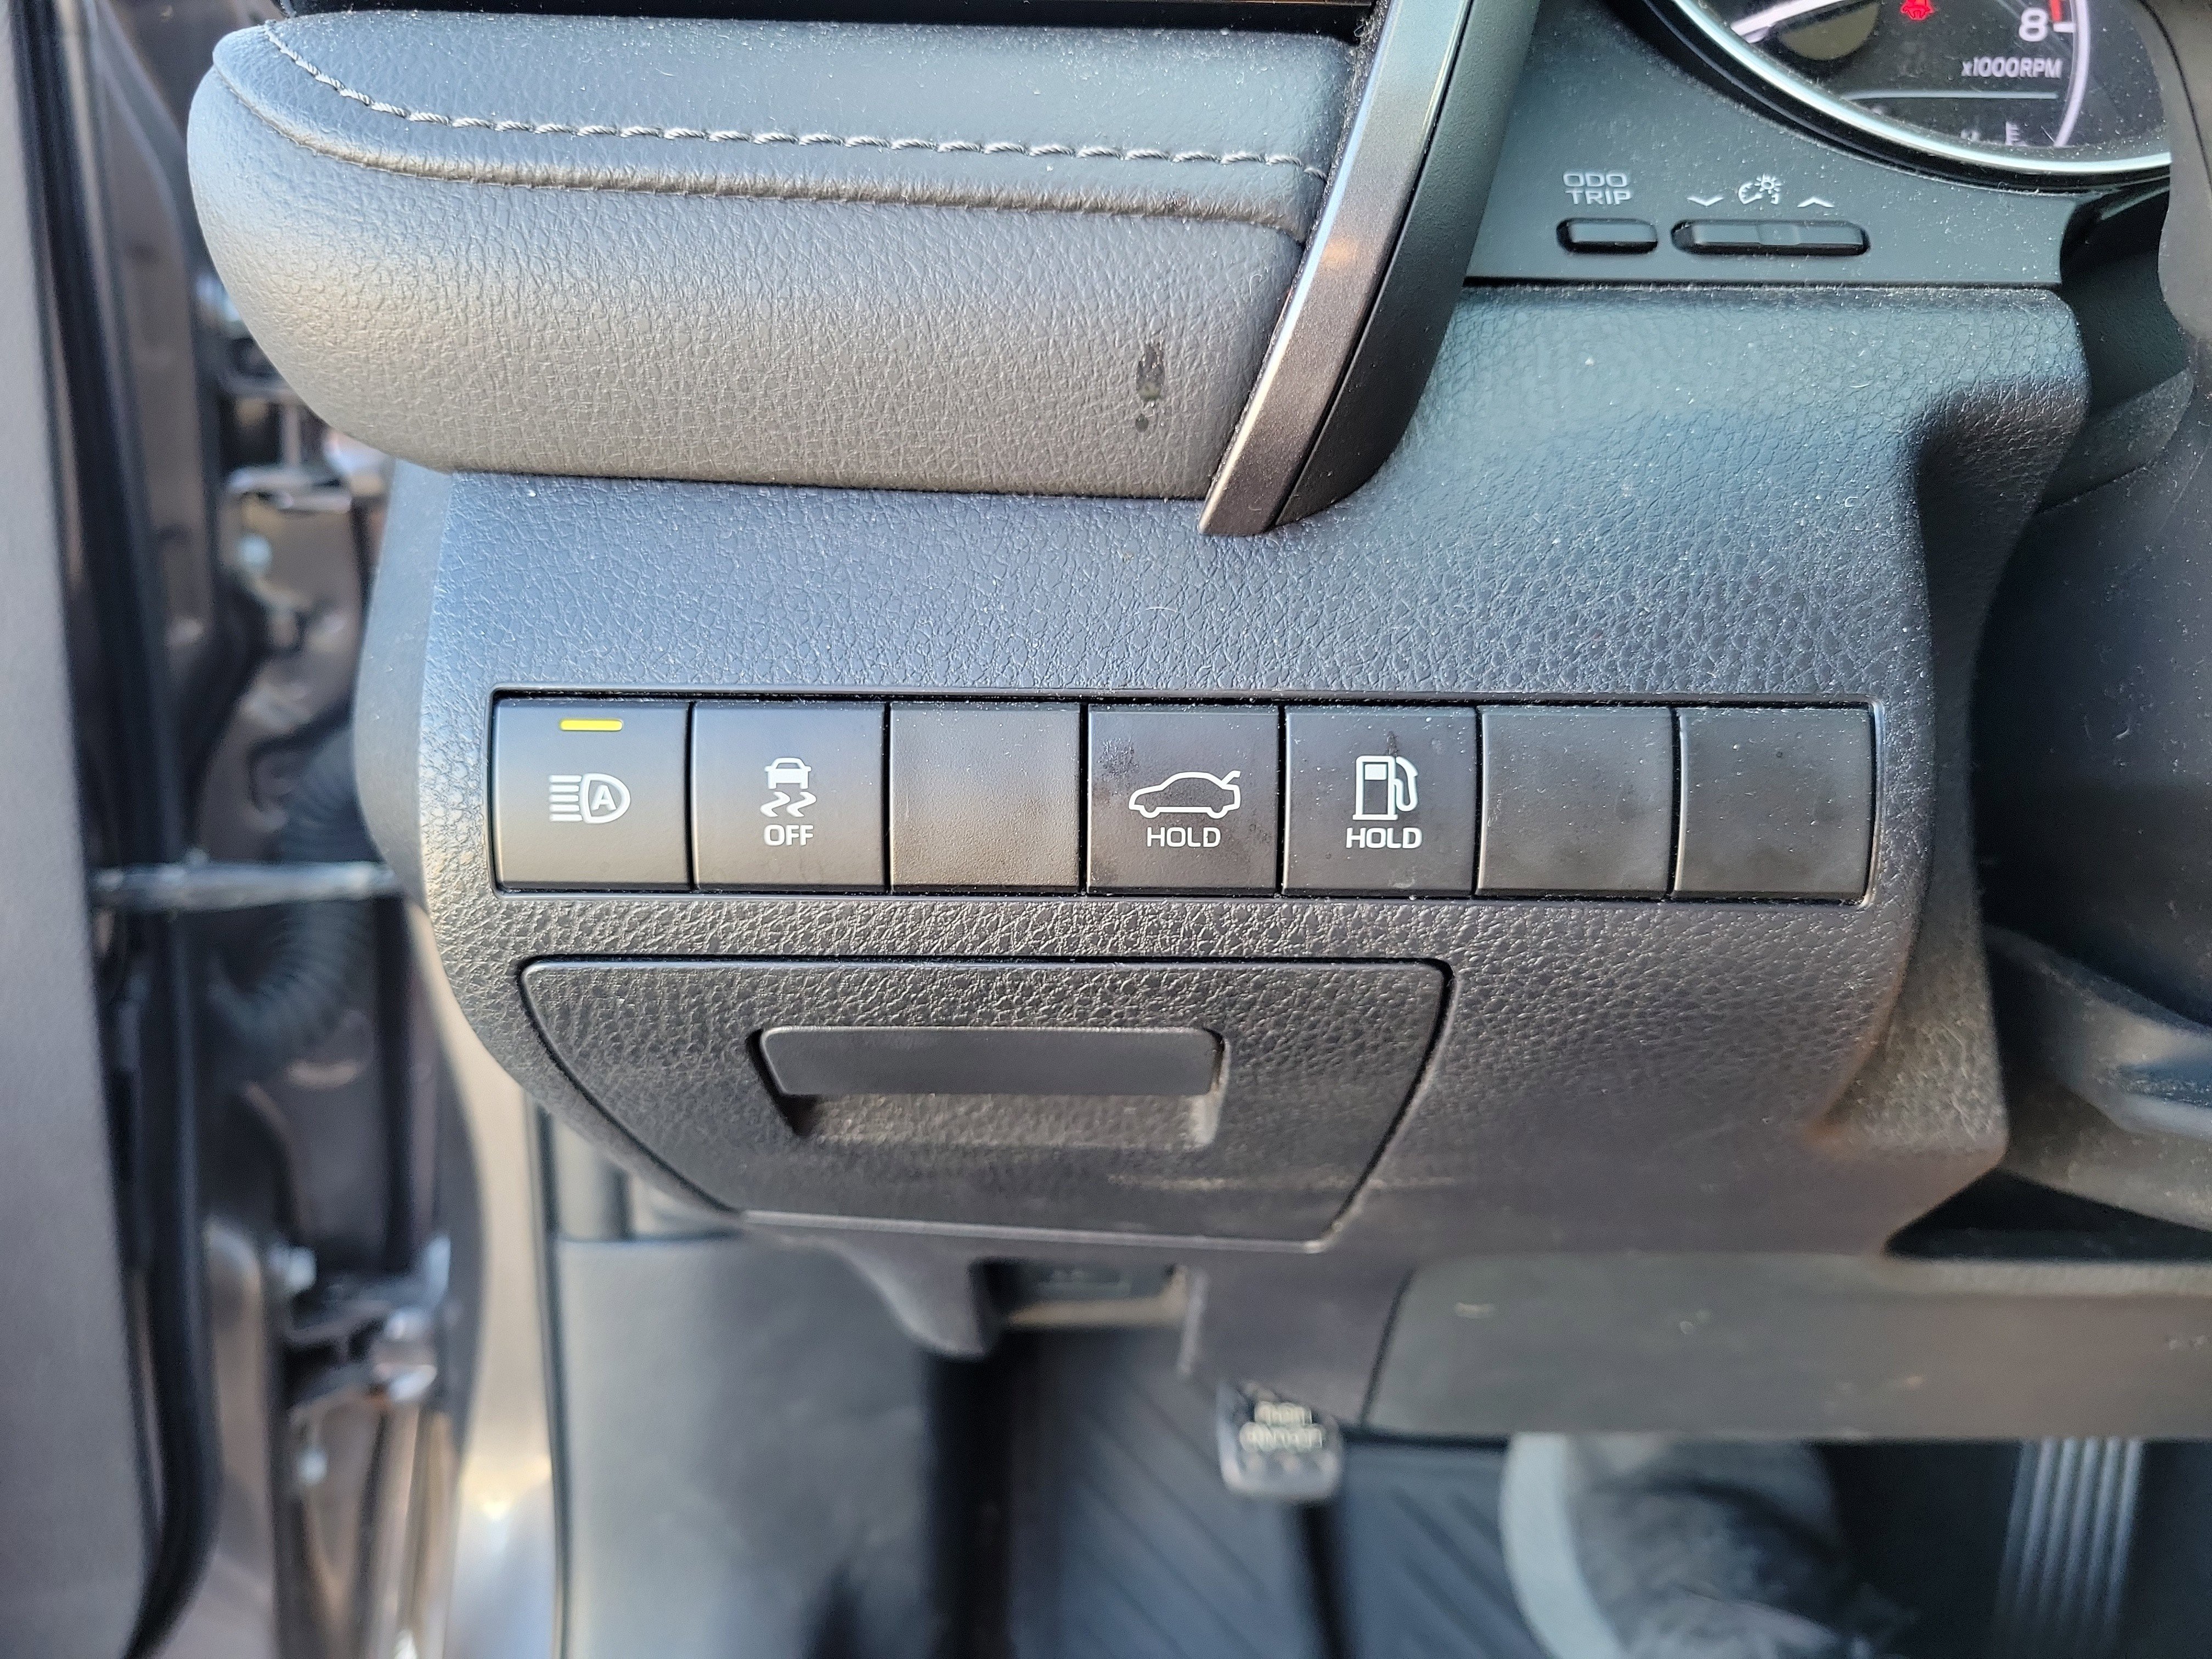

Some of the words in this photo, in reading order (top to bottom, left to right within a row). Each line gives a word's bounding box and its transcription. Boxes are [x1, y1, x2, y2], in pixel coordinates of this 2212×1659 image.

[2018, 7, 2049, 42] 8
[1563, 171, 1628, 188] ODO
[1564, 189, 1632, 205] TRIP
[763, 824, 814, 847] OFF
[1147, 826, 1222, 848] HOLD
[1346, 827, 1423, 849] HOLD
